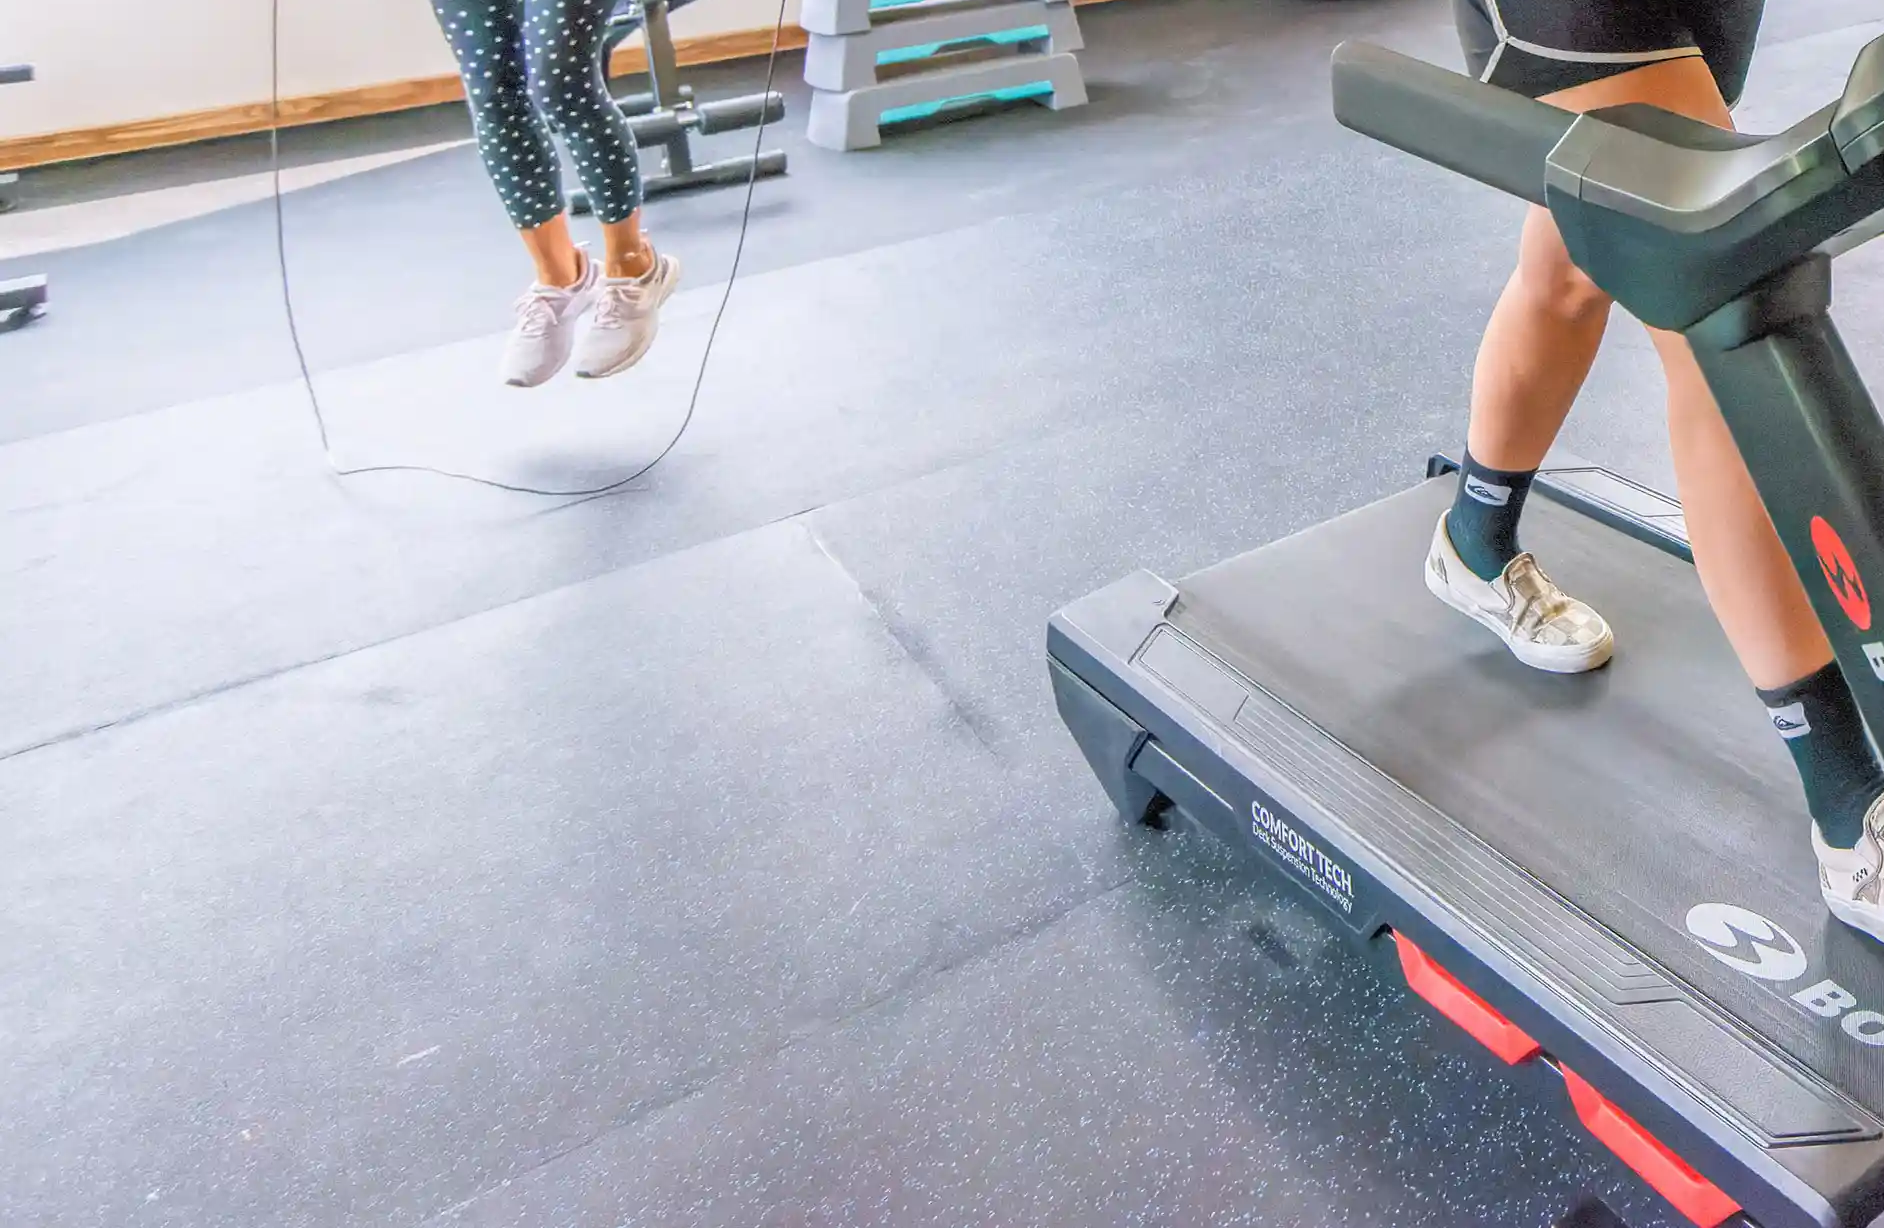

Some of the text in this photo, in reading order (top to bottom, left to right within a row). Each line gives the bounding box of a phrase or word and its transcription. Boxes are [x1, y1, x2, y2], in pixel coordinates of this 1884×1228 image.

[1251, 800, 1316, 864] COMFORT
[1252, 821, 1353, 914] Deck Suspension Technology
